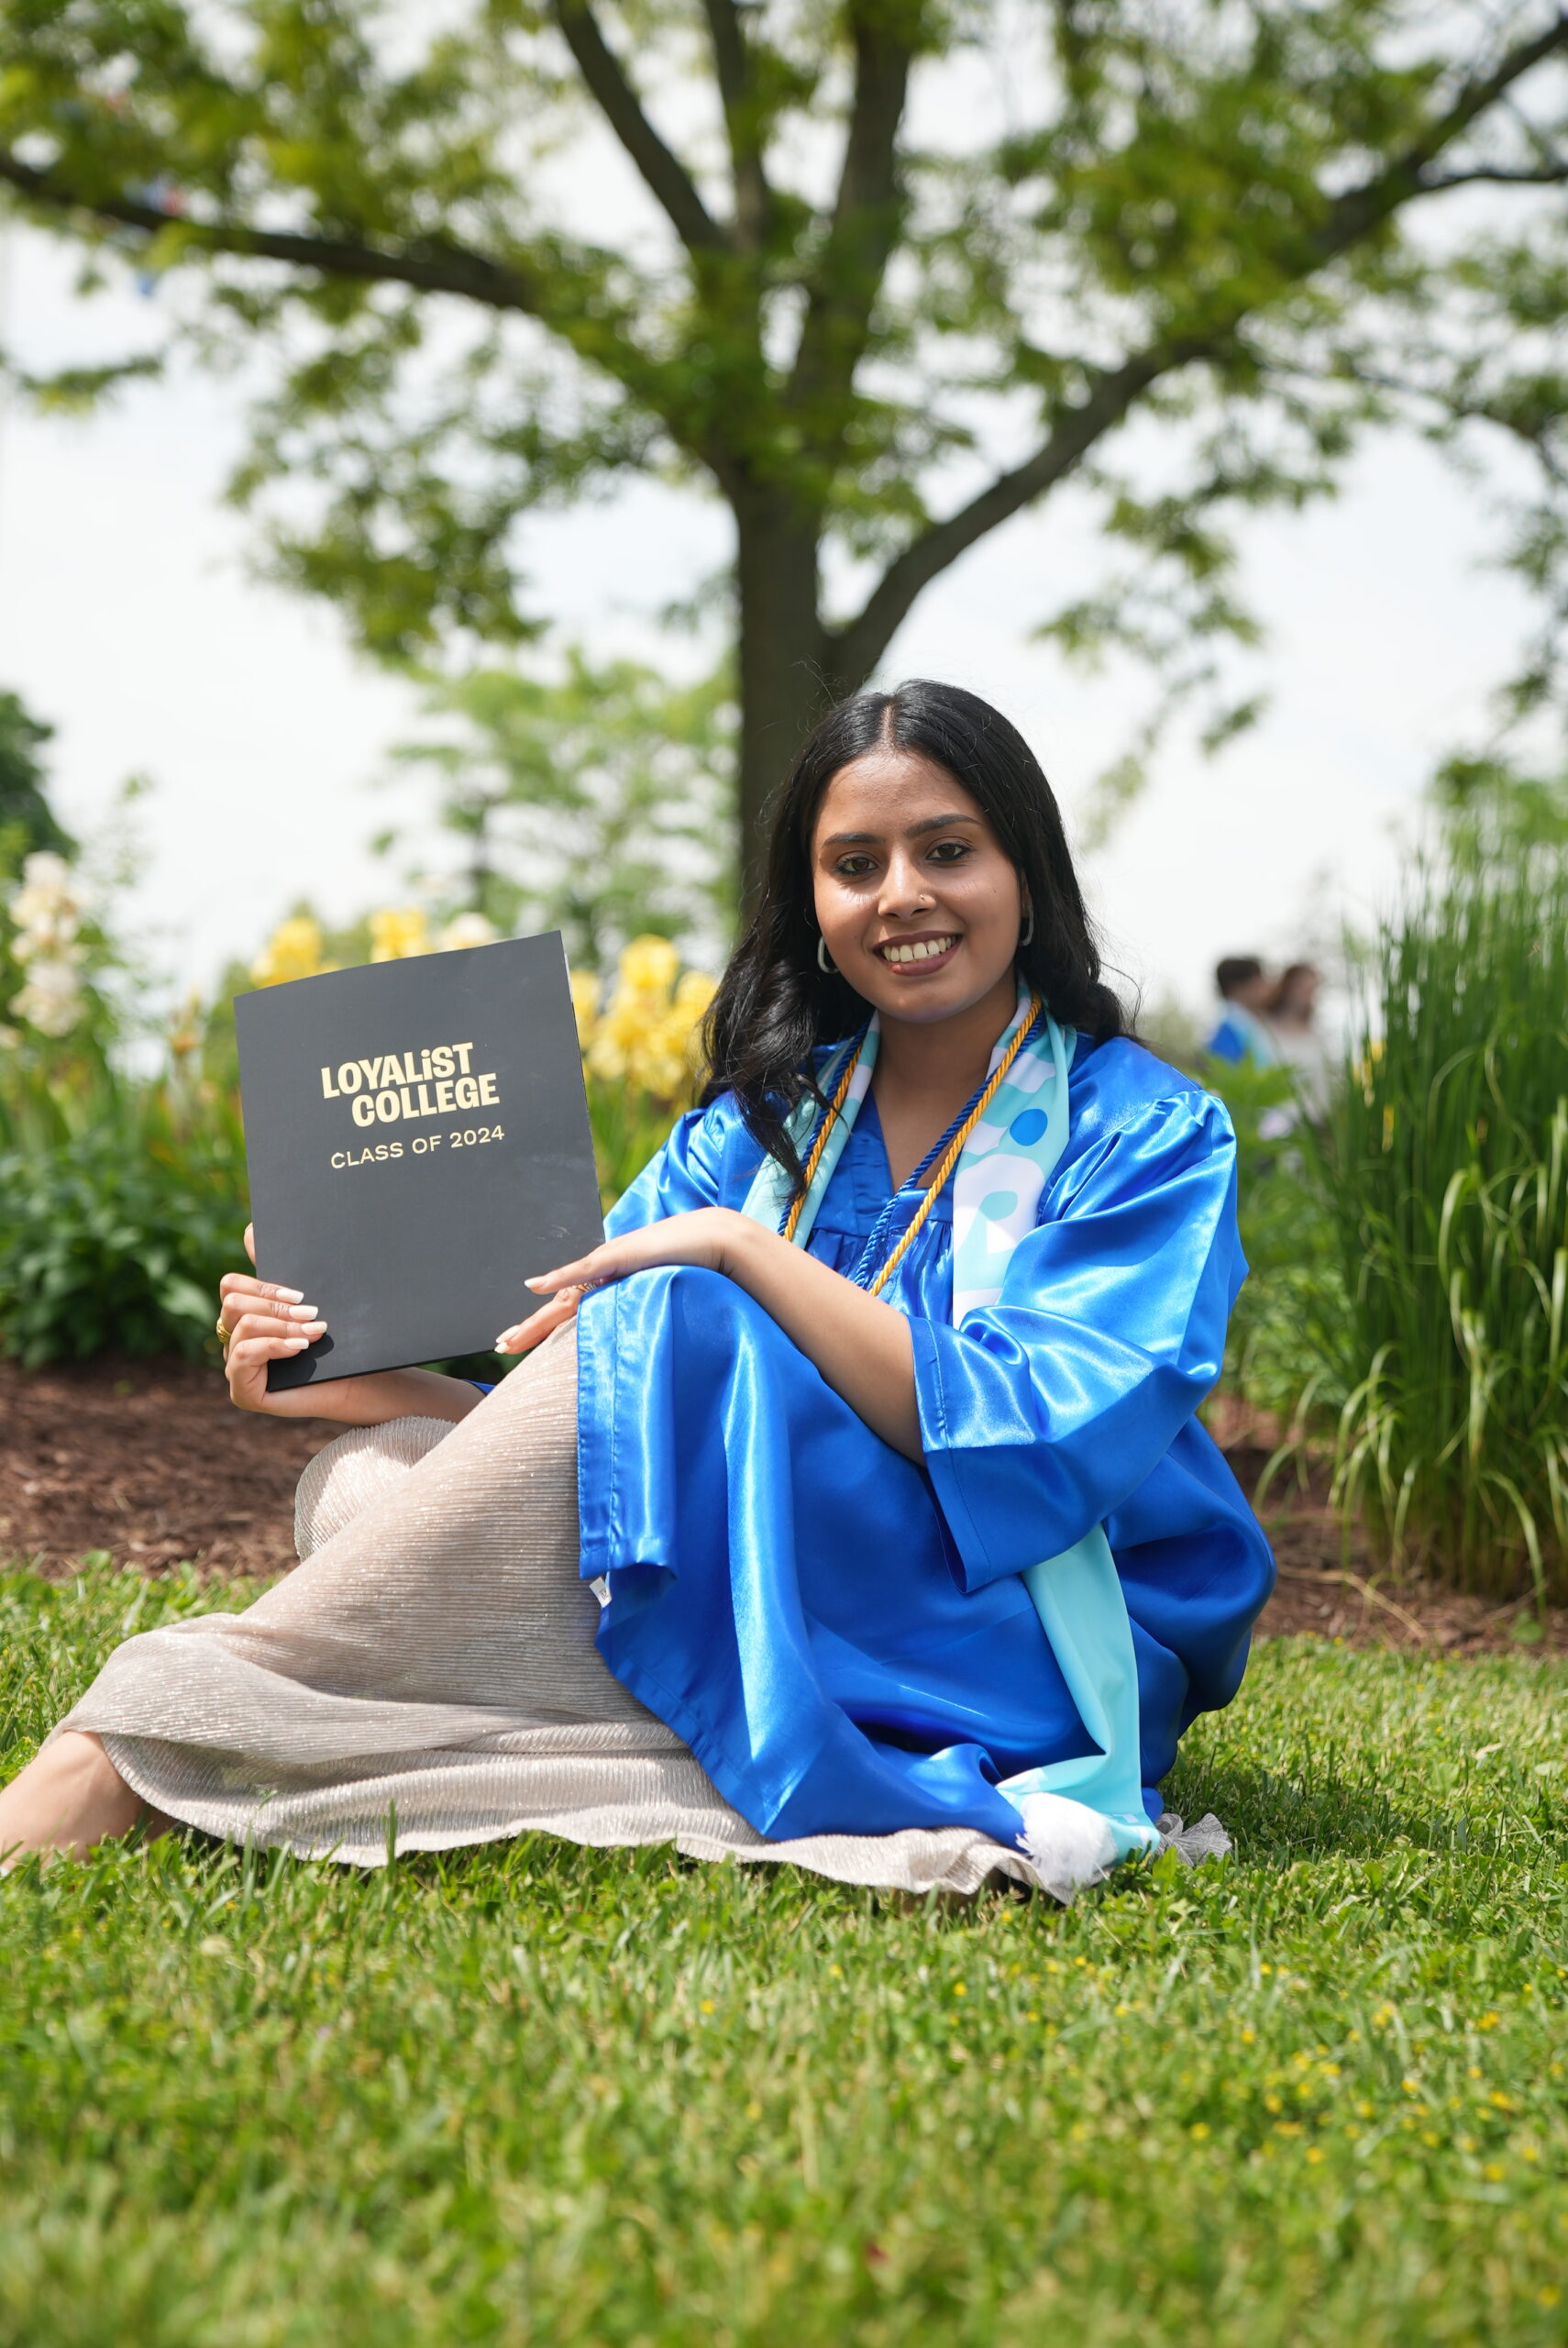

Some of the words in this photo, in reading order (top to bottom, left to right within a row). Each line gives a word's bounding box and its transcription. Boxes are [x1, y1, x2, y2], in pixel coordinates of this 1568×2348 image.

[321, 1042, 473, 1099] LOYALiST
[351, 1072, 501, 1127] COLLEGE
[331, 1141, 404, 1169] CLASS
[412, 1135, 442, 1154] OF
[450, 1124, 505, 1148] 2024
